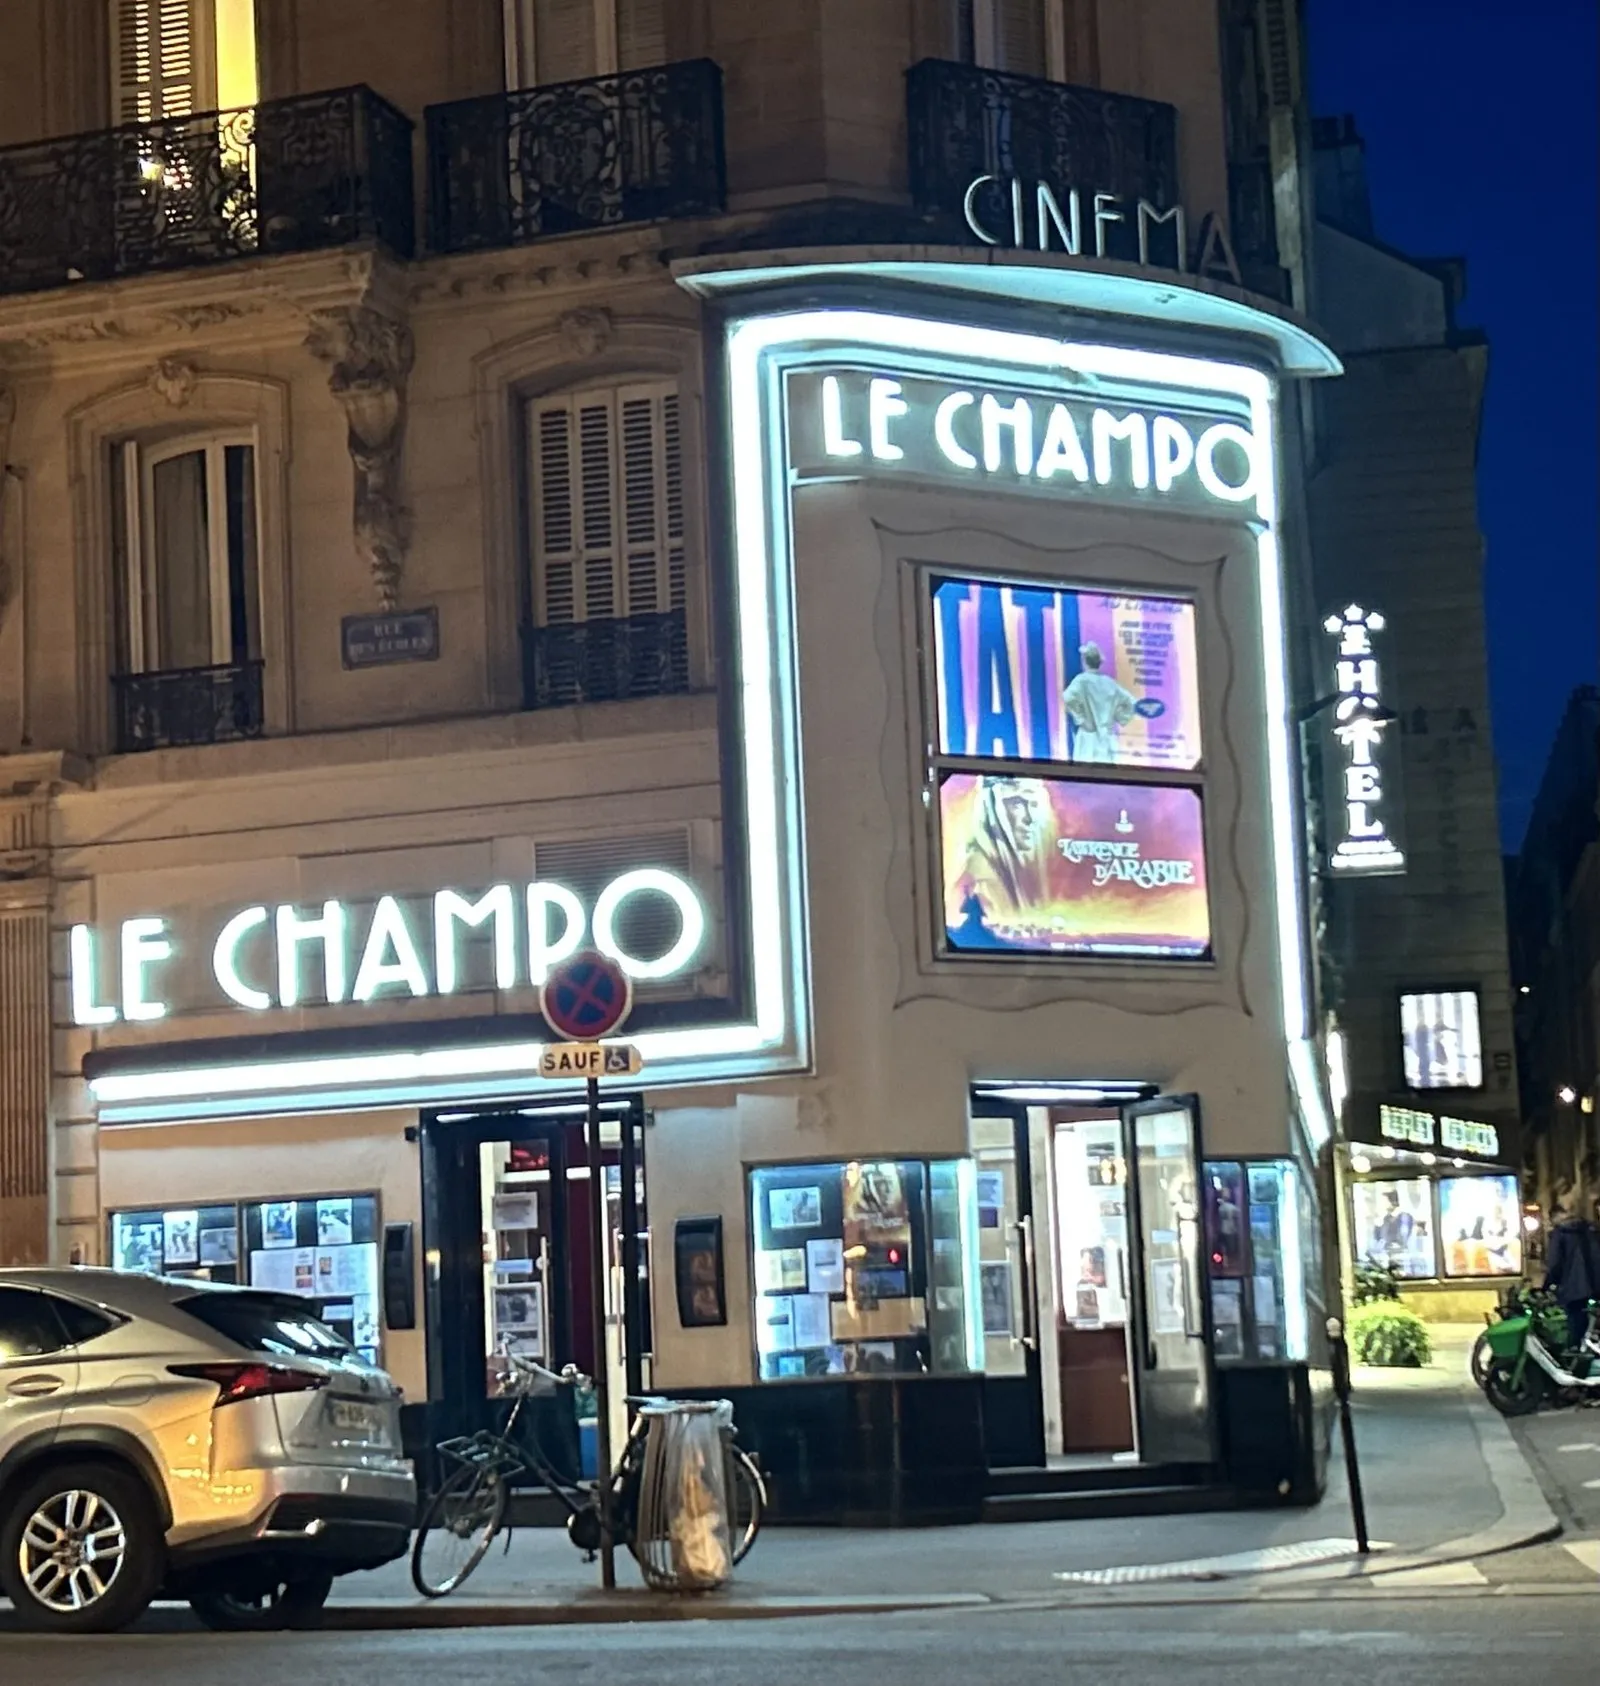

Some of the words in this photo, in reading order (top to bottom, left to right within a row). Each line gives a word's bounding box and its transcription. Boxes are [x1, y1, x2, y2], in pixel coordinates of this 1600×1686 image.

[821, 375, 908, 460] LE
[934, 390, 1258, 502] CHAMPO
[69, 917, 172, 1025] LE
[211, 867, 704, 1009] CHAMPO
[543, 1051, 600, 1071] SAUF
